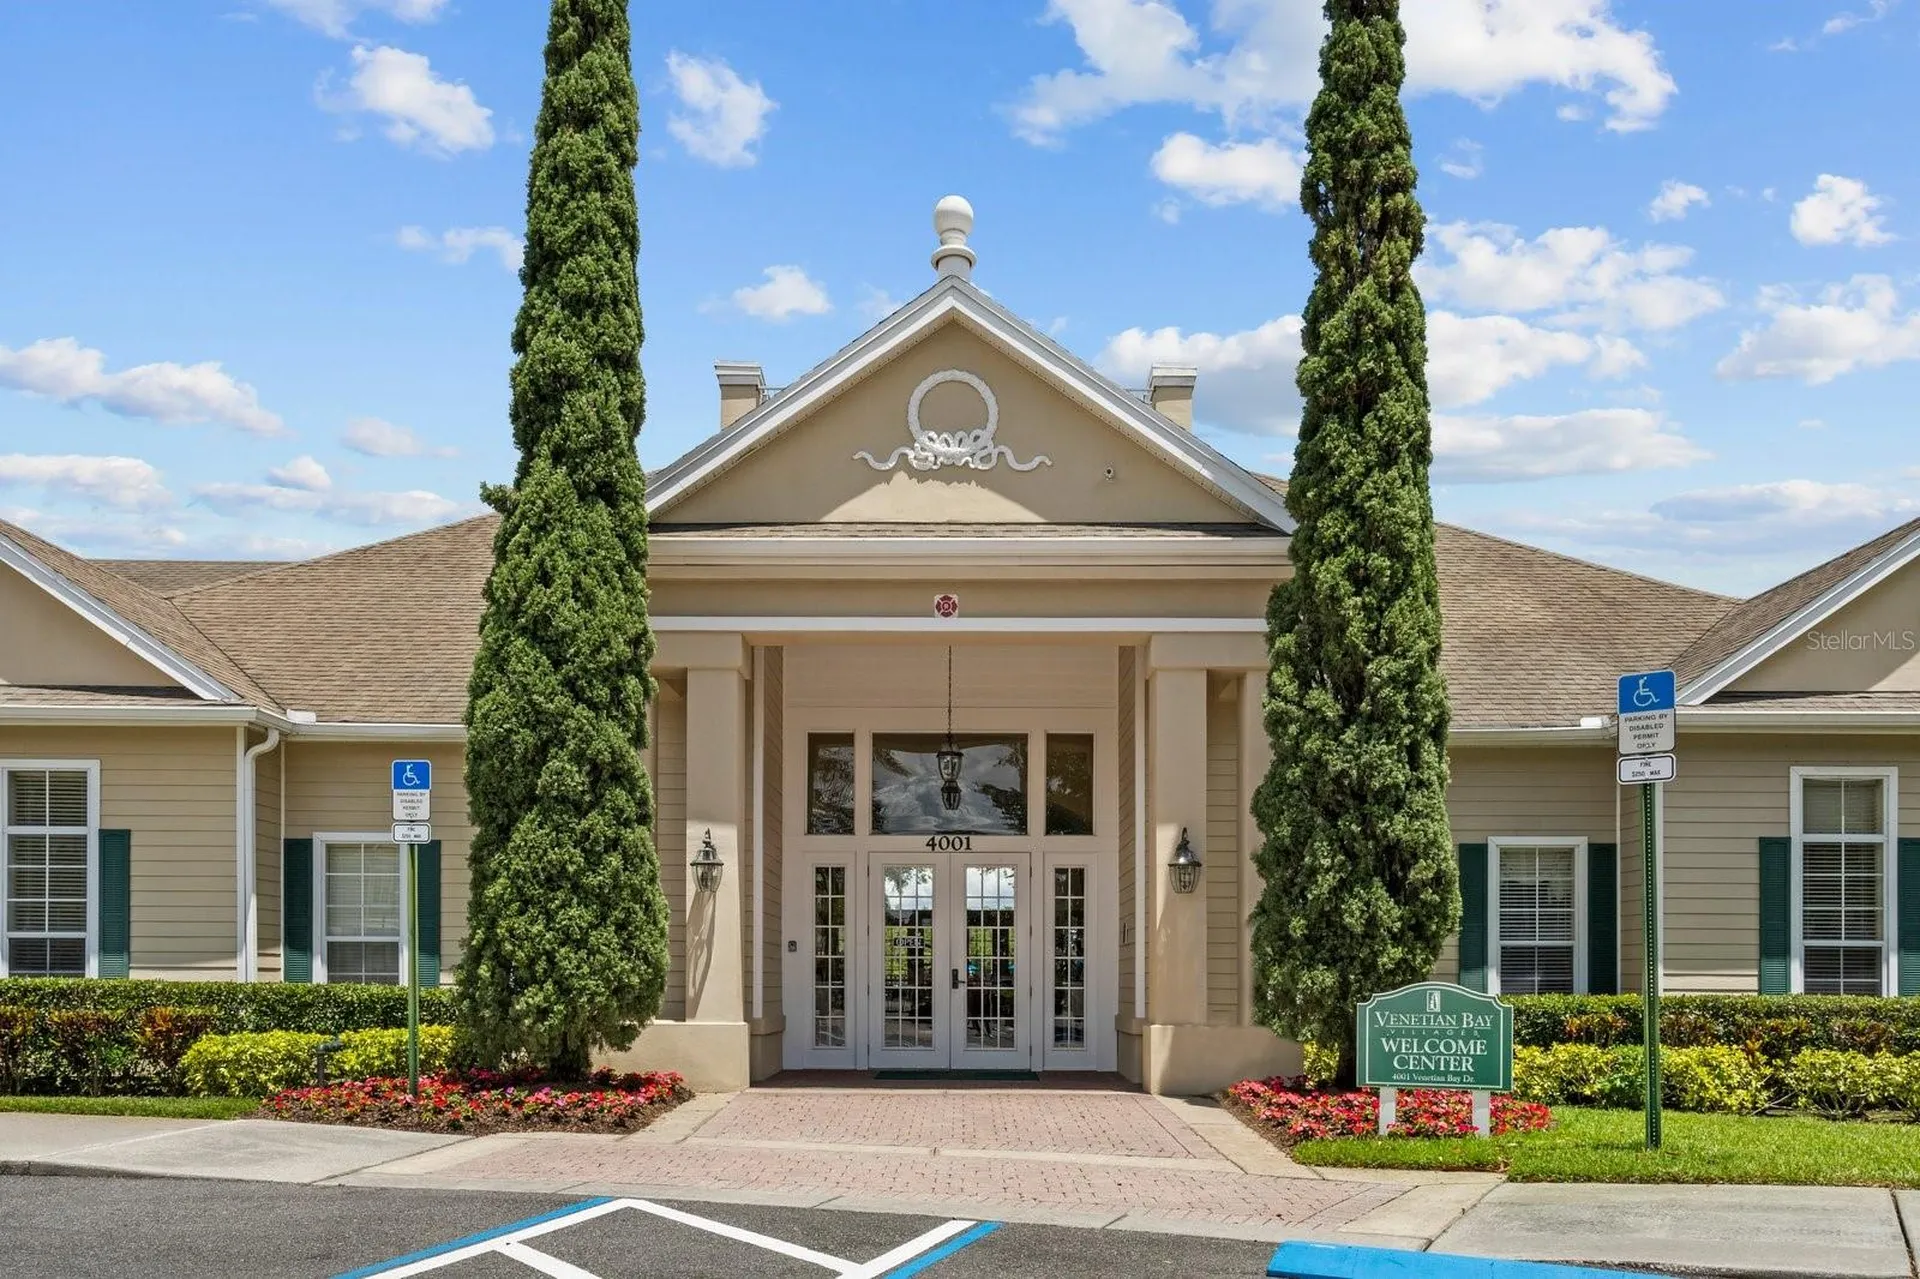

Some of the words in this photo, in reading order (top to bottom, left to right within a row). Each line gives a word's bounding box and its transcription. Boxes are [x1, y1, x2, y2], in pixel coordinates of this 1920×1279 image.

[1625, 714, 1656, 722] PARKING
[1629, 723, 1664, 731] DISABLED
[1633, 732, 1659, 740] PERMIT
[925, 835, 972, 851] 4001
[1375, 1011, 1457, 1027] VENETIAN
[1461, 1012, 1494, 1028] BAY
[1380, 1037, 1487, 1055] WELCOME
[1393, 1054, 1475, 1072] CENTER
[1392, 1073, 1410, 1081] 4001
[1412, 1073, 1446, 1082] Venetian
[1447, 1074, 1461, 1084] Bay
[1463, 1075, 1476, 1083] Dr.
